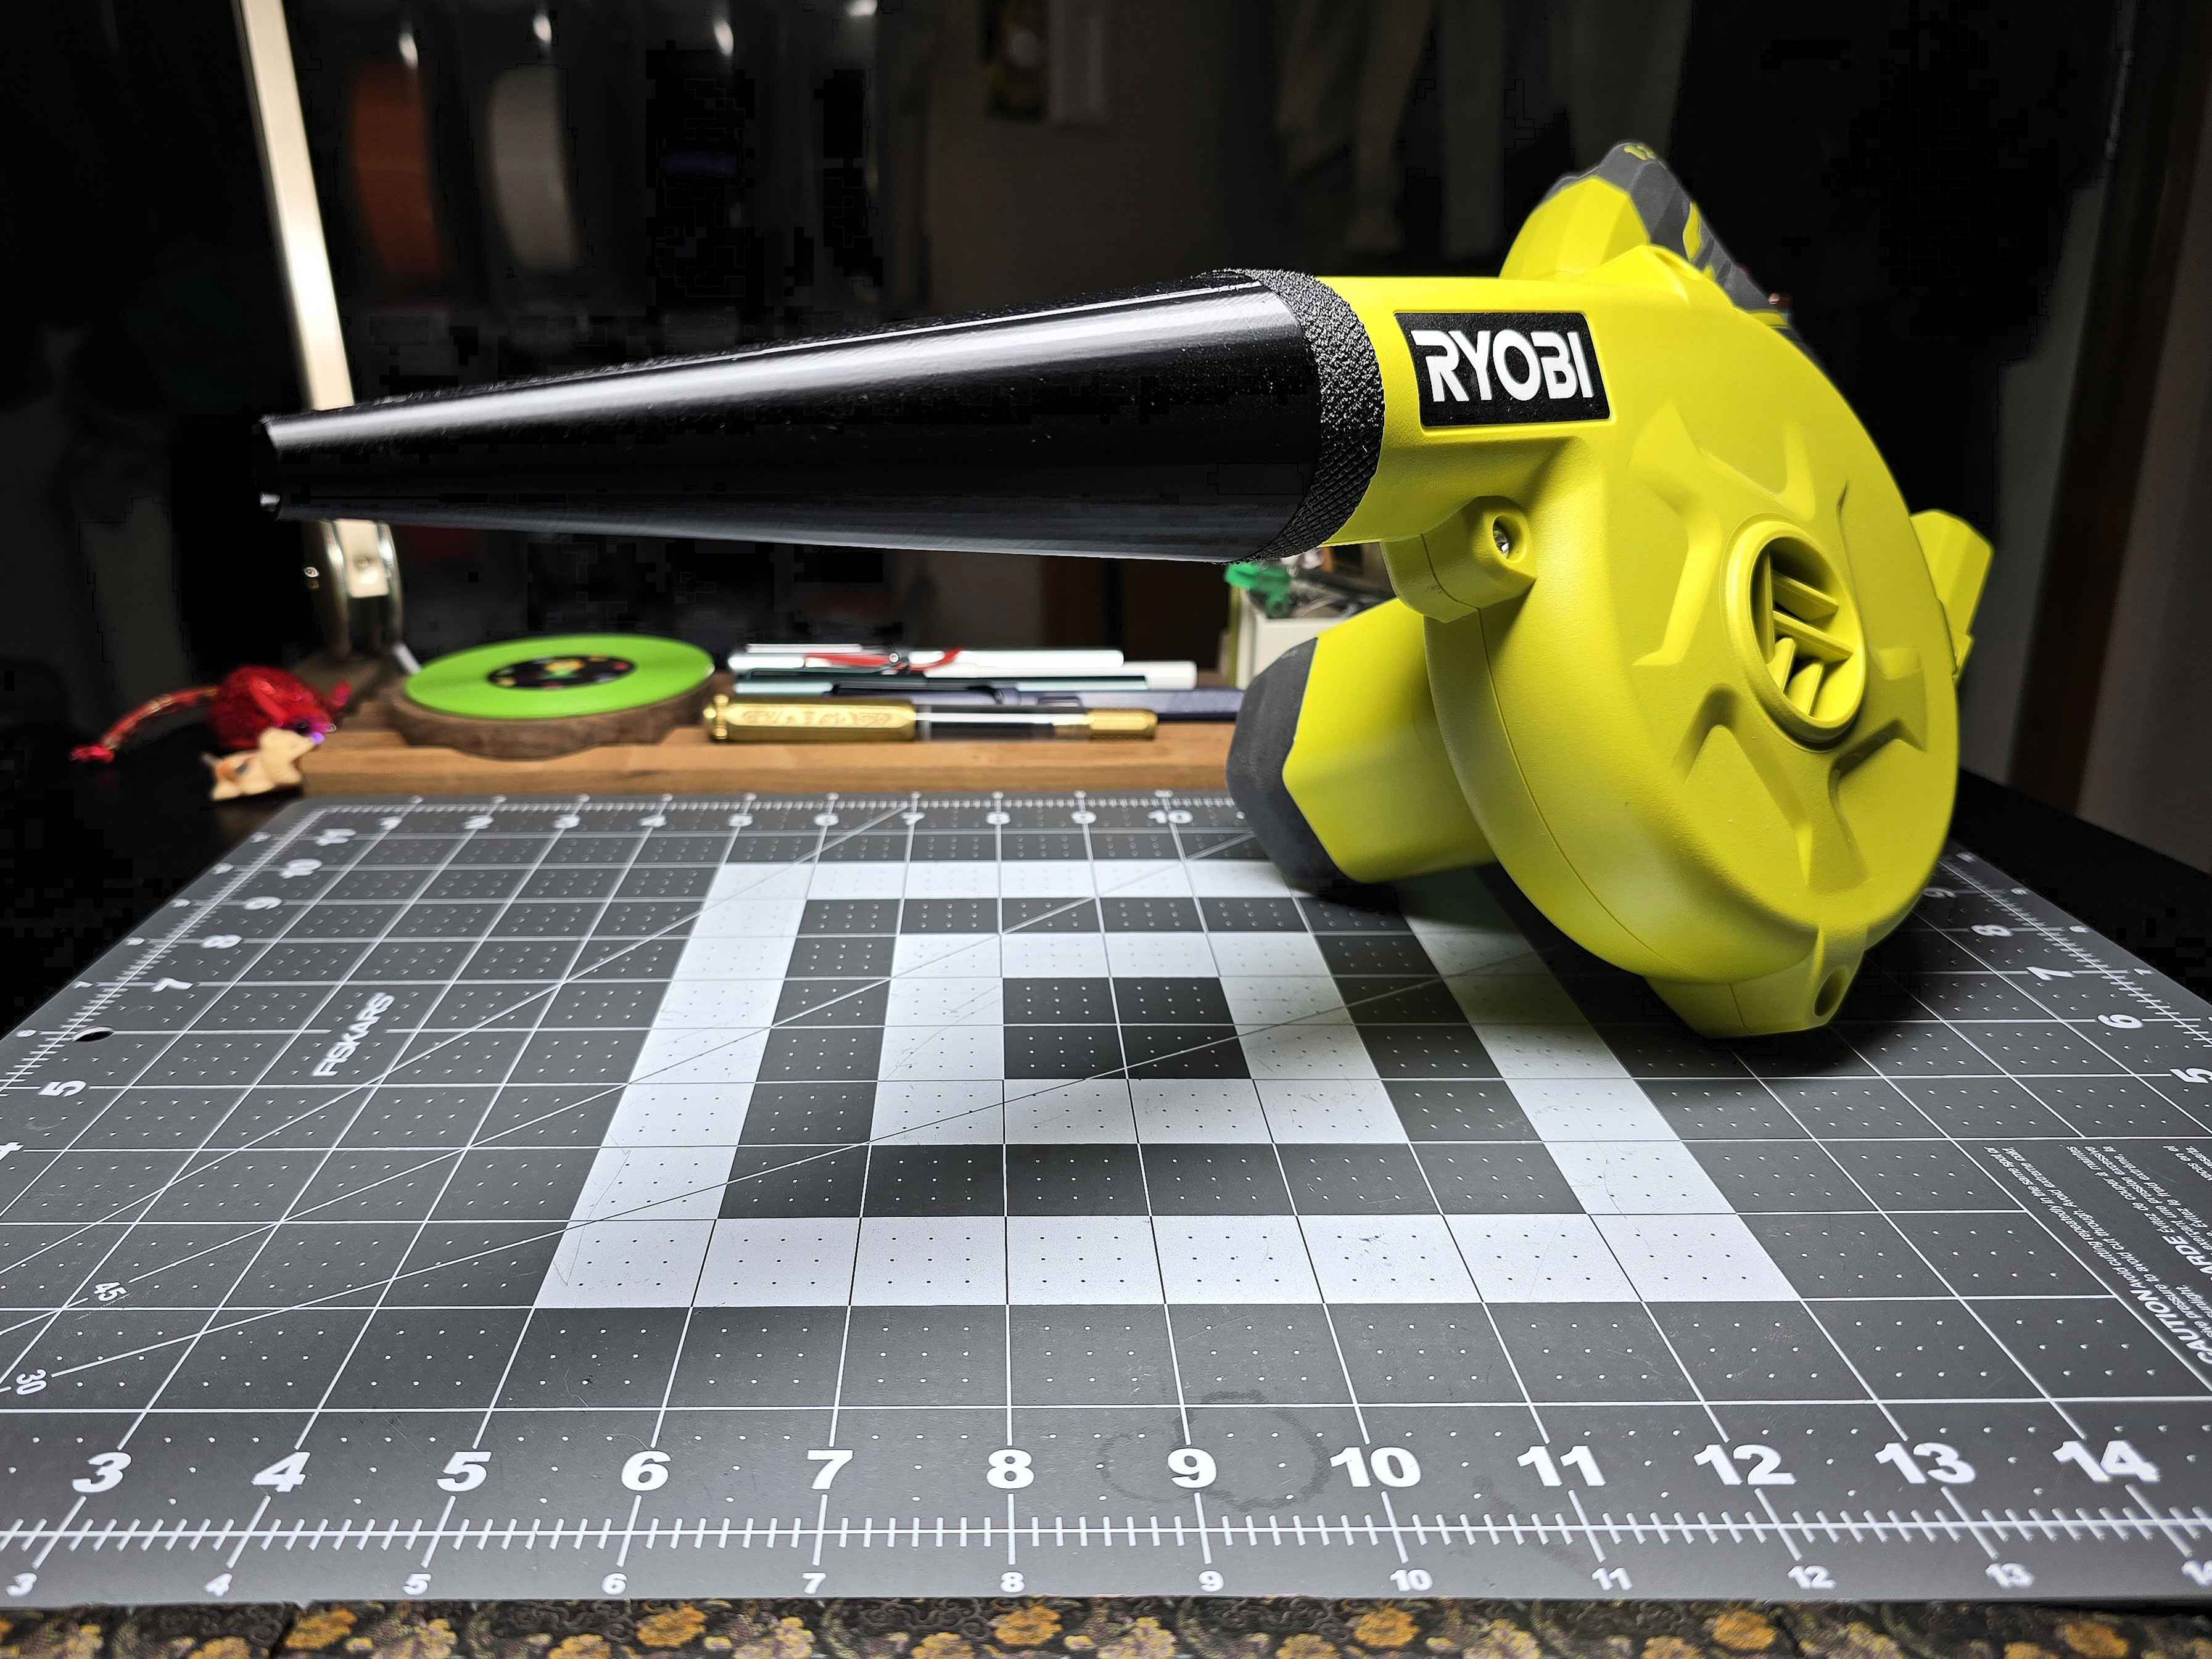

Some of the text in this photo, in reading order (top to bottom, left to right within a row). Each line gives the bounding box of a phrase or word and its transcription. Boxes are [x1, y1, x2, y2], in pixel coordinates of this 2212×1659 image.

[1411, 329, 1594, 402] RYOBI
[1147, 809, 1194, 825] 10
[1971, 924, 2013, 937] 8
[2026, 966, 2075, 981] 7
[38, 1079, 87, 1097] 5
[151, 977, 193, 993] 7
[200, 934, 242, 950] 8
[2097, 1014, 2144, 1029] 6
[310, 992, 395, 1077] FISKARS
[2169, 1068, 2212, 1084] 5
[1990, 1153, 2015, 1167] spot
[2007, 1167, 2037, 1185] same
[2020, 1162, 2057, 1188] extreme
[2027, 1185, 2047, 1197] the
[2047, 1189, 2078, 1208] Avoid
[2102, 1177, 2137, 1200] couper
[2132, 1202, 2149, 1211] de
[2155, 1205, 2177, 1218] une
[2047, 1204, 2094, 1240] repeatedly
[2072, 1208, 2110, 1237] through.
[2087, 1241, 2122, 1266] cutting
[2102, 1238, 2124, 1250] cut
[2116, 1252, 2149, 1272] avoid
[2111, 1267, 2147, 1288] Avoid
[93, 1281, 127, 1301] 45
[2154, 1284, 2203, 1319] pressure
[2129, 1290, 2212, 1364] CAUTION
[15, 1369, 47, 1395] 30
[72, 1438, 2158, 1493] 3 4 5 6 7 8 9 10 11 12 13 14
[7, 1573, 36, 1595] 3
[205, 1574, 232, 1596] 4
[403, 1574, 431, 1595] 5
[602, 1573, 627, 1594] 6
[803, 1572, 827, 1595] 7
[1000, 1571, 1025, 1594] 8
[1198, 1570, 1224, 1592] 9
[1390, 1570, 1432, 1591] 10
[1592, 1568, 1632, 1590] 11
[1788, 1566, 1835, 1588] 12
[1986, 1564, 2031, 1586] 13
